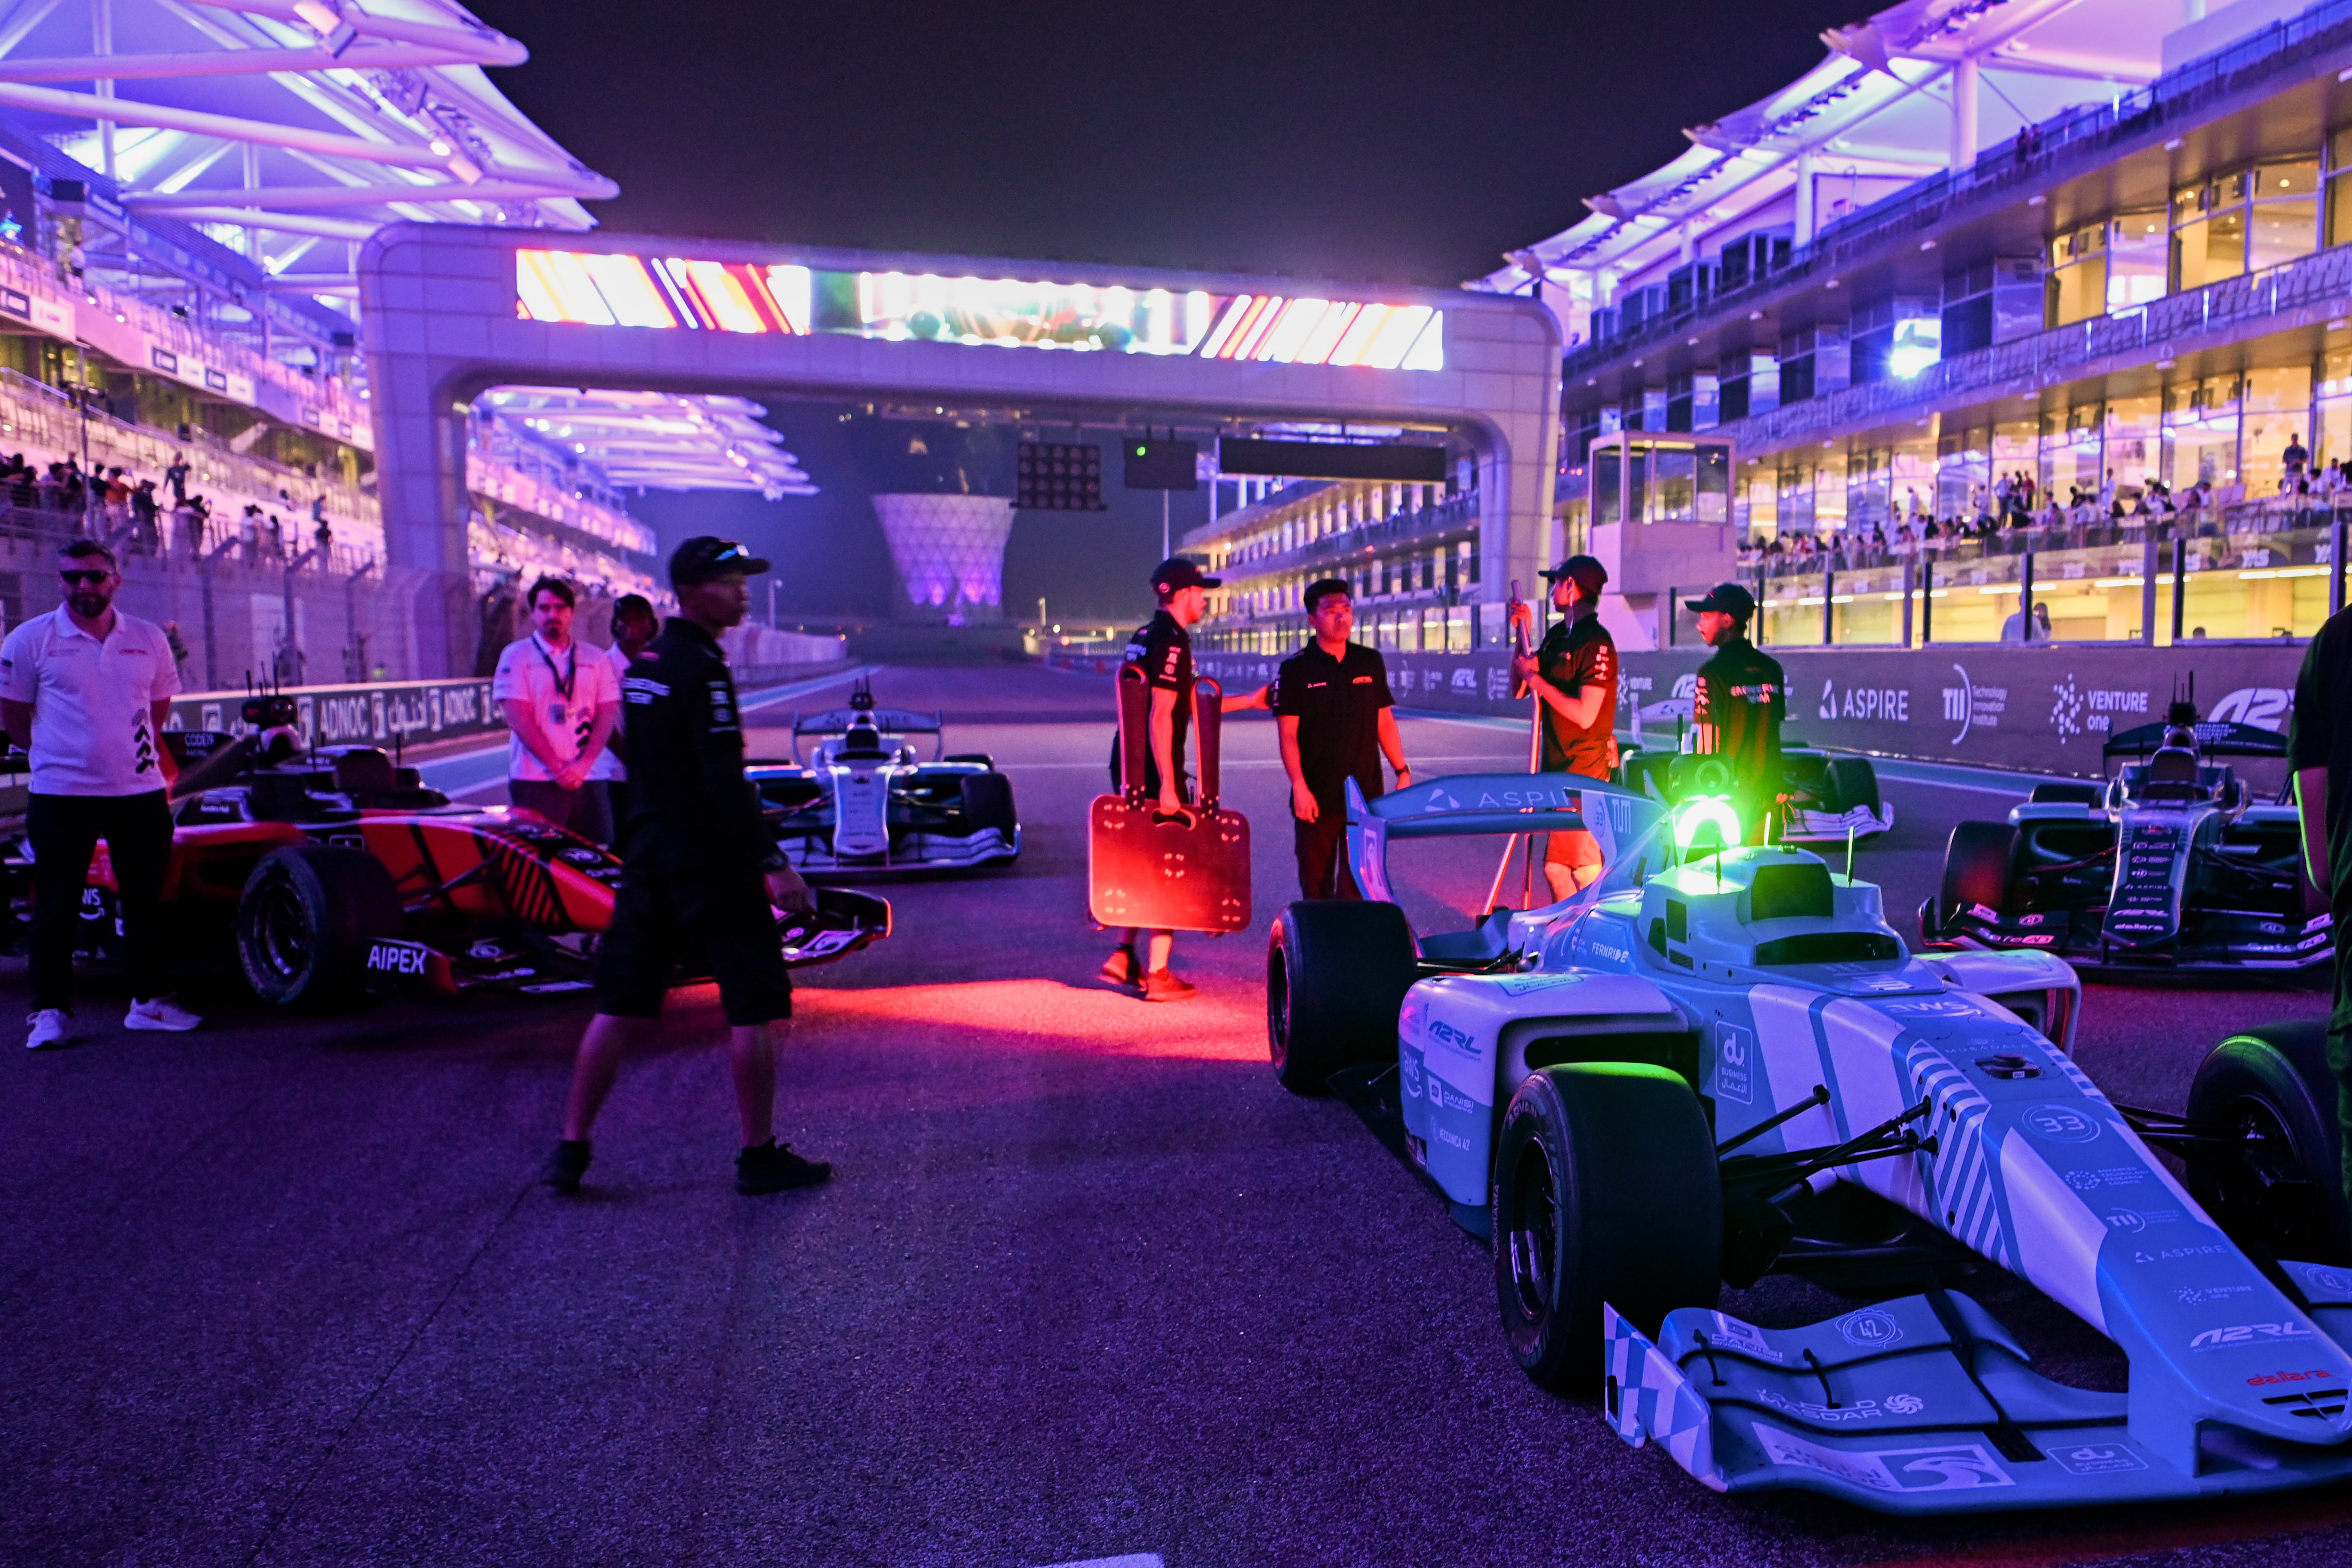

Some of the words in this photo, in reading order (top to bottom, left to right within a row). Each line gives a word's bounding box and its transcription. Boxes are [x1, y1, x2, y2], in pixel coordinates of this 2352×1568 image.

[1972, 685, 2008, 700] Technology
[2087, 690, 2148, 713] VENTURE
[445, 686, 477, 724] ADNOC
[1843, 689, 1908, 721] ASPIRE
[1943, 688, 1965, 720] TII
[1972, 701, 2005, 712] Innovation
[2207, 687, 2295, 731] A2
[320, 696, 368, 740] ADNOC
[1972, 714, 1997, 726] Institute
[2087, 715, 2110, 730] one
[1479, 791, 1570, 808] ASPI
[82, 888, 100, 905] WS
[367, 945, 427, 974] AIPEX
[1591, 941, 1629, 963] FERNRIDE
[1724, 1032, 1745, 1067] du
[1404, 1051, 1420, 1082] aws
[1721, 1067, 1747, 1082] BUSINESS
[1444, 1091, 1475, 1109] DANISI
[2035, 1115, 2085, 1133] 33
[1462, 1138, 1470, 1151] 42
[2161, 1244, 2227, 1259] ASPIRE
[2204, 1285, 2254, 1294] VENTURE
[1859, 1319, 1882, 1338] 42
[2247, 1369, 2333, 1387] dallara
[1759, 1393, 1883, 1422] MASDAR
